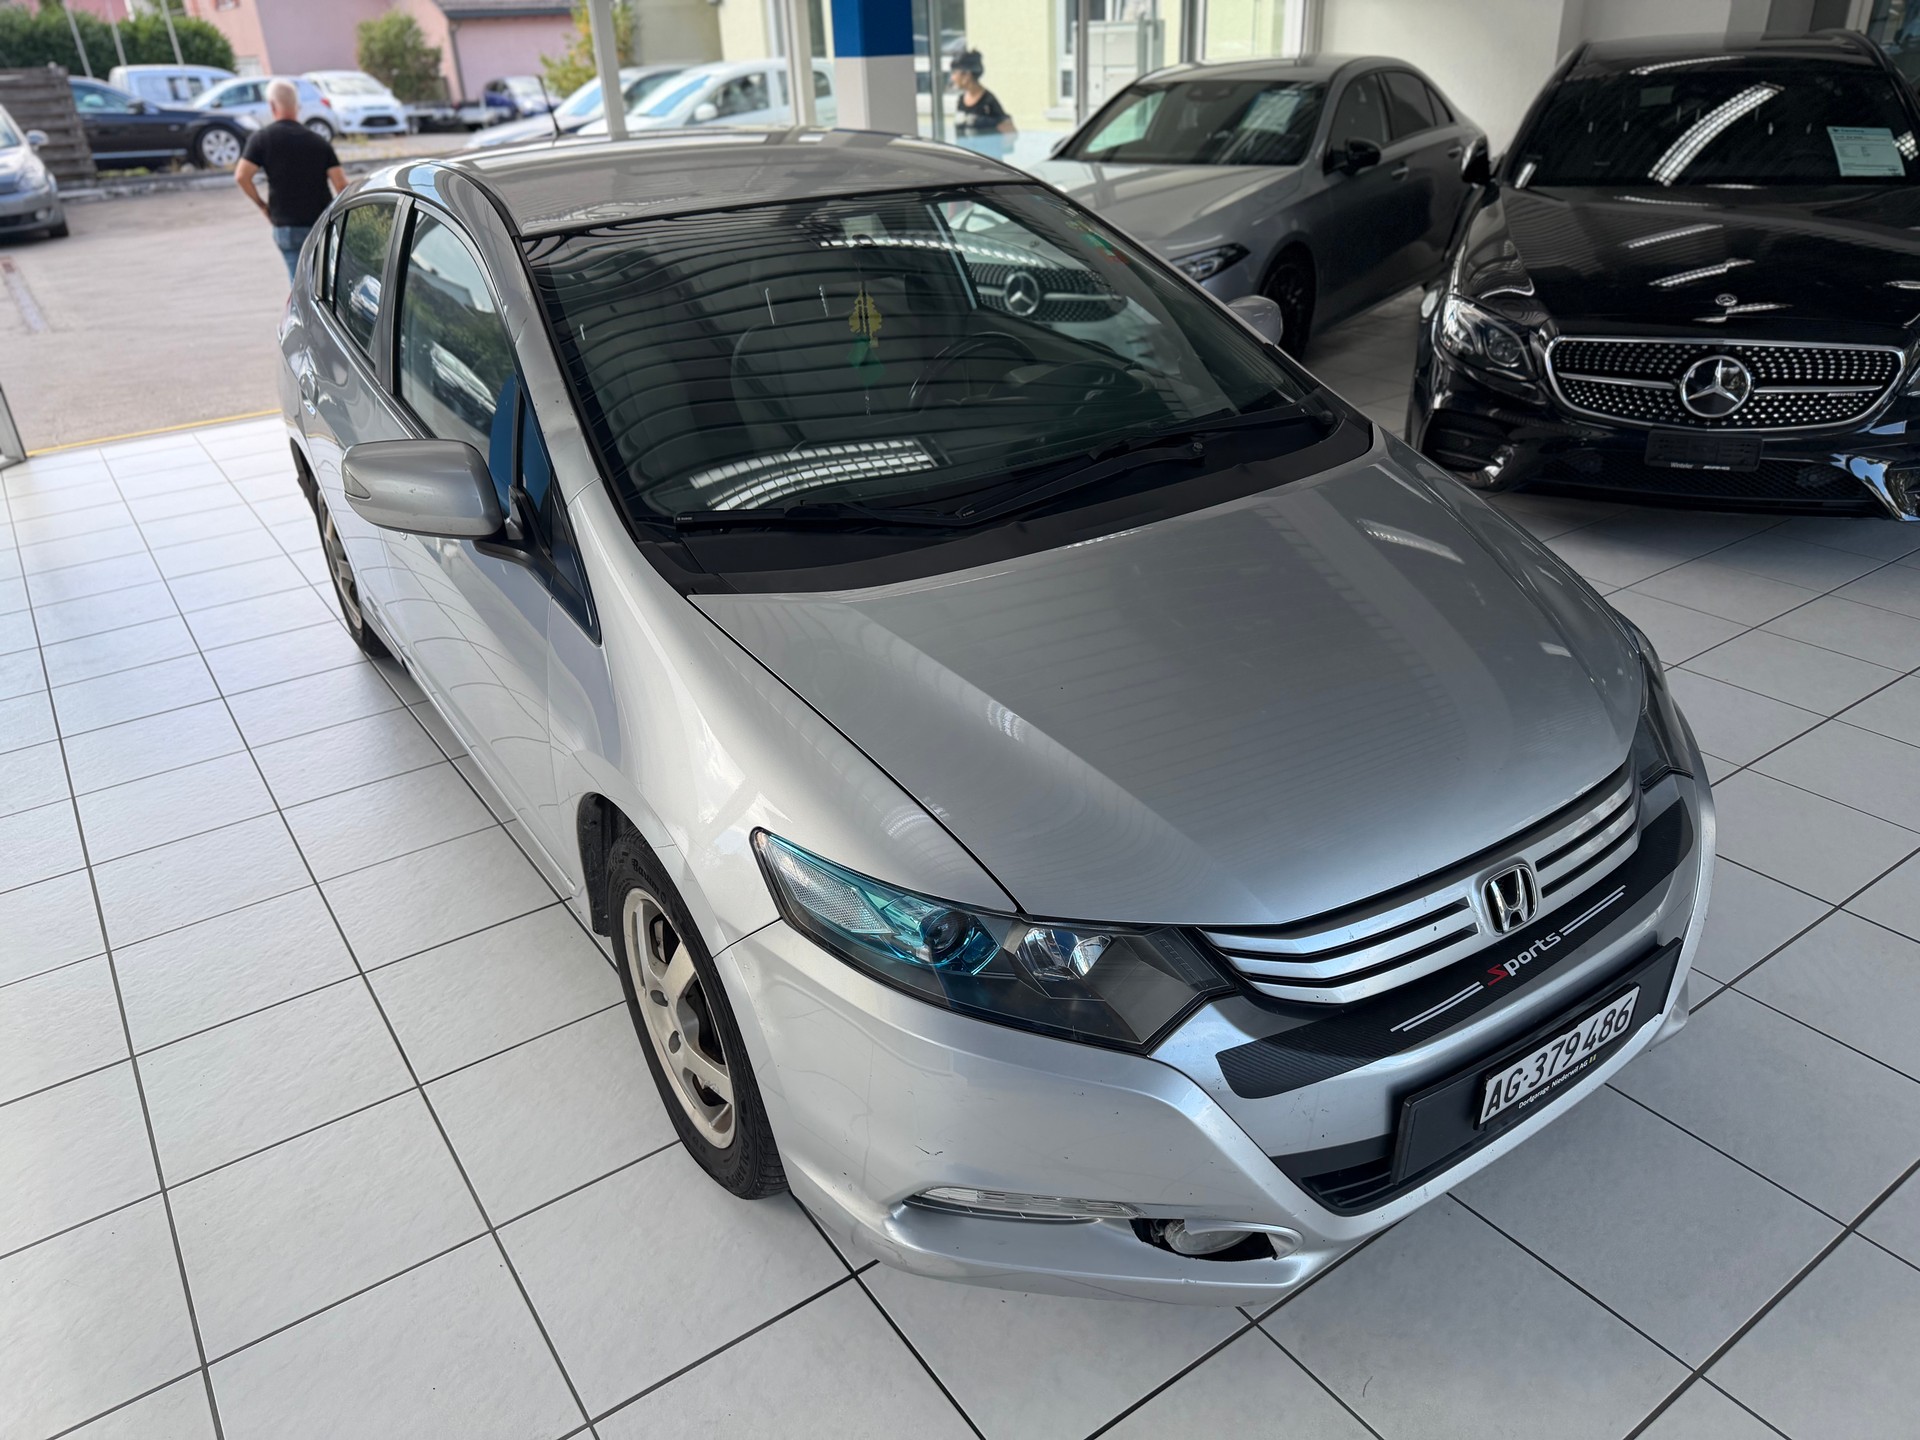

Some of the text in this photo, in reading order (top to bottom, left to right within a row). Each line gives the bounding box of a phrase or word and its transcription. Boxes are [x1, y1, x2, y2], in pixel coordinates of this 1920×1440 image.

[1487, 932, 1562, 986] Sports
[1518, 1060, 1588, 1109] Dorfgarage Niederwil AG
